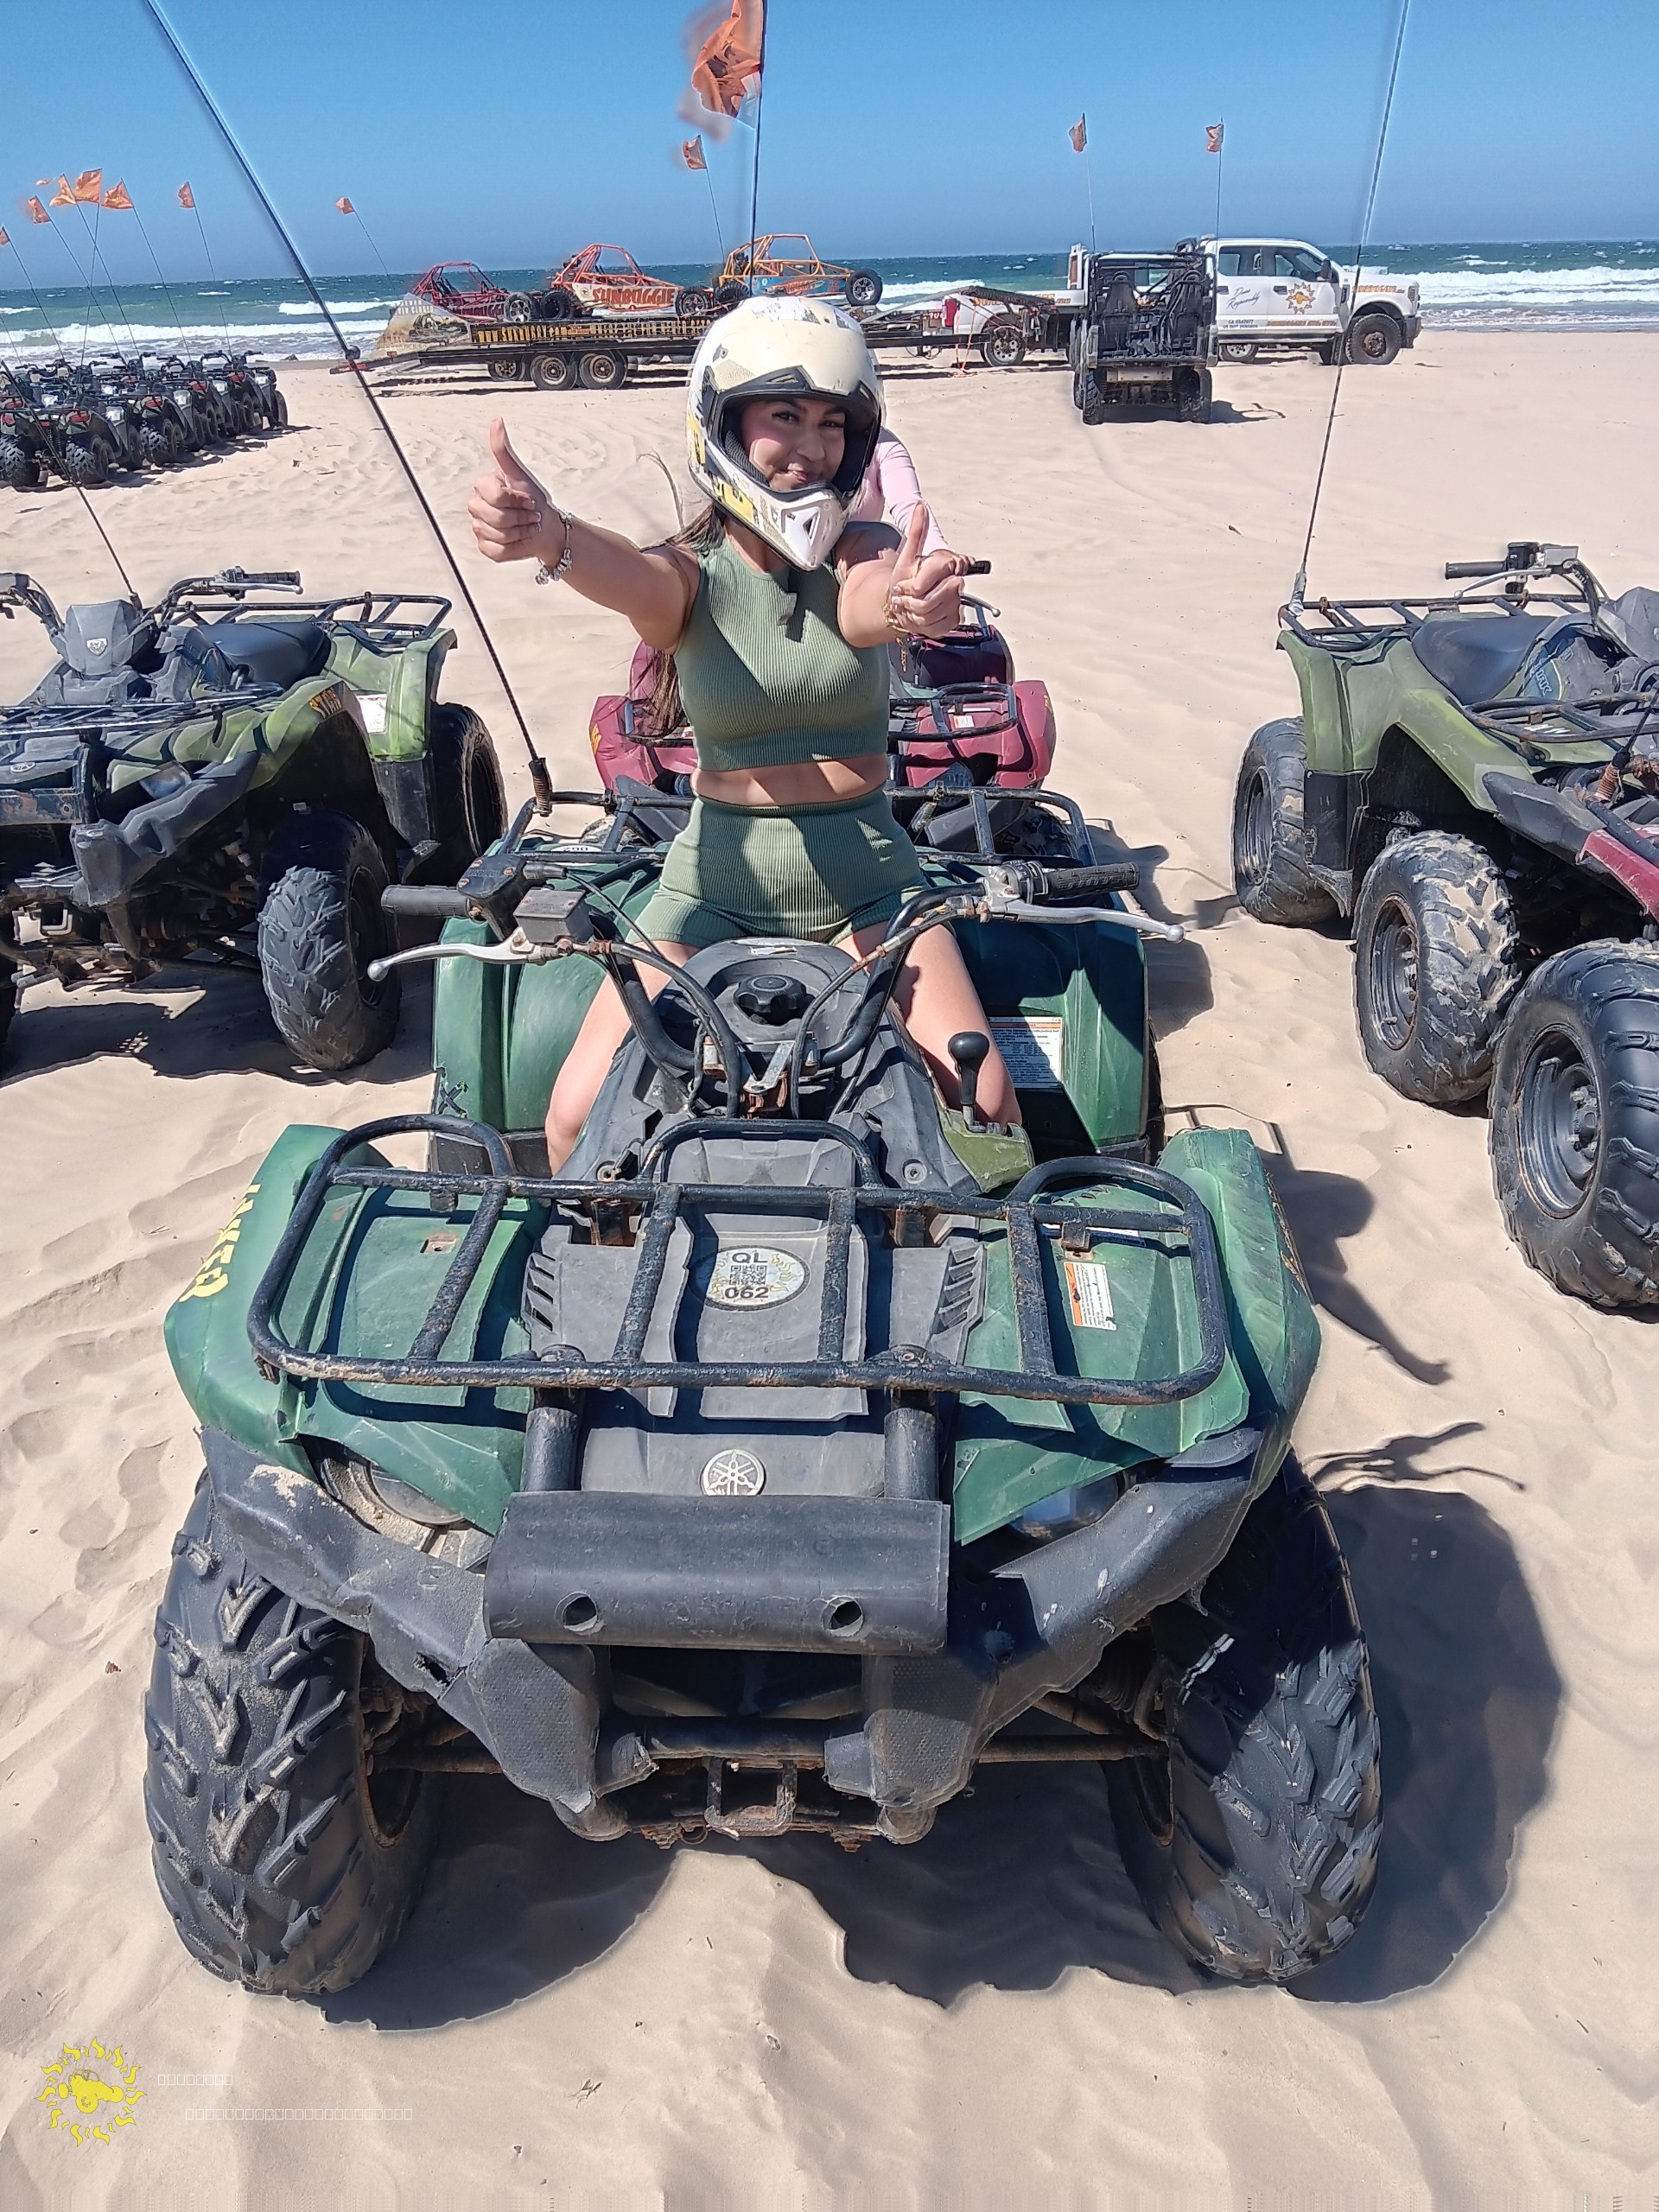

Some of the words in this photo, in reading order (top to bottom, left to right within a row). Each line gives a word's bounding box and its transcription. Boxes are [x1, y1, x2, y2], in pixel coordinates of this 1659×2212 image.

[592, 287, 676, 305] SUNBUGGIE
[732, 1252, 768, 1264] QL
[724, 1287, 769, 1300] 062
